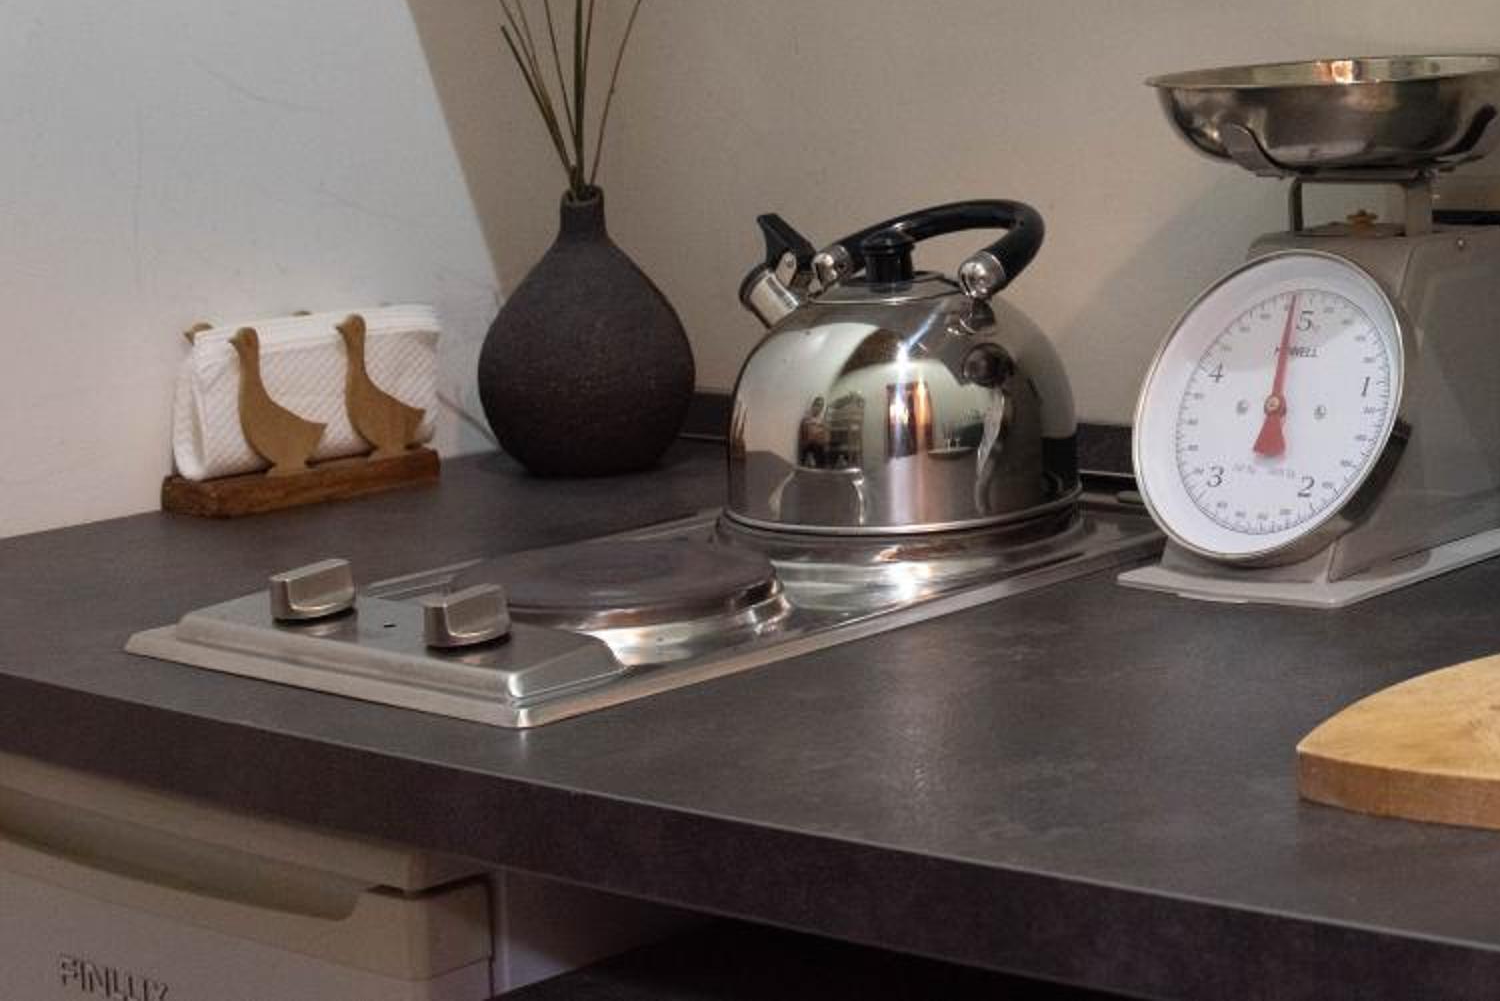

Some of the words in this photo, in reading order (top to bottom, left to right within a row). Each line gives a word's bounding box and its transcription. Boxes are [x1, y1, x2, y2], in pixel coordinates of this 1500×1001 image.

[1296, 310, 1315, 332] 5
[1208, 361, 1225, 384] 4
[1361, 376, 1371, 398] 1
[1207, 465, 1225, 488] 3
[1297, 475, 1316, 498] 2
